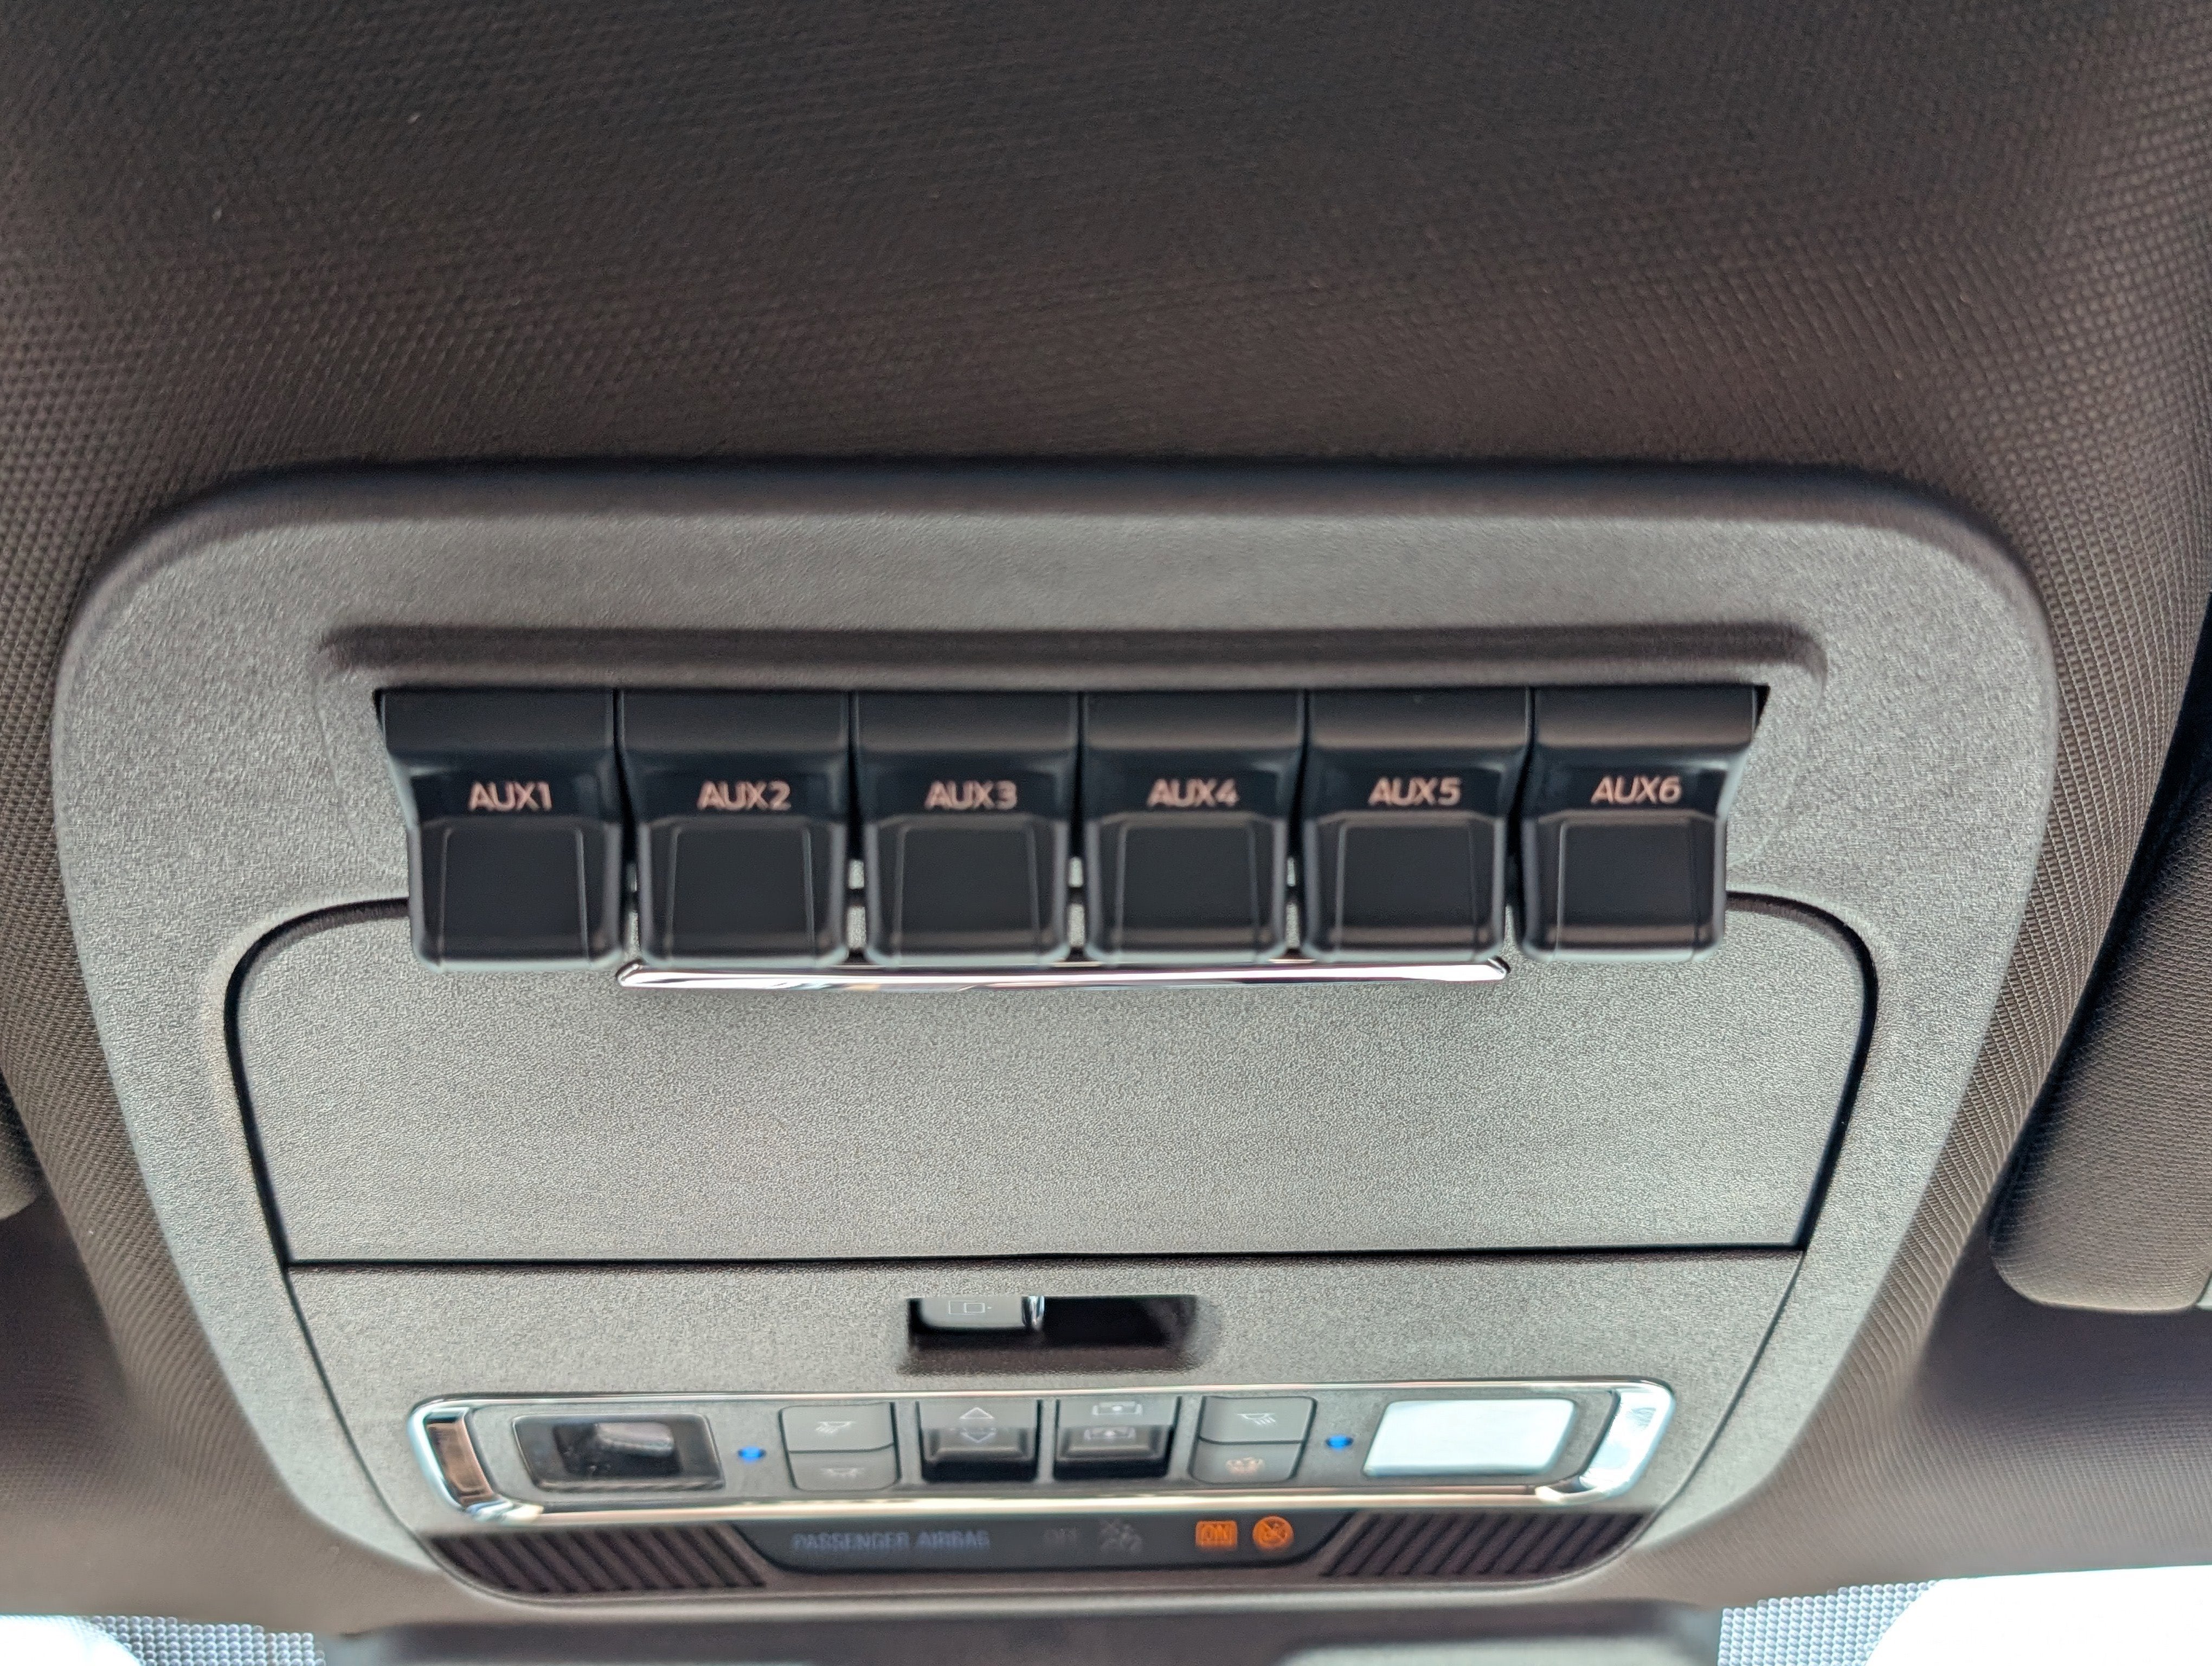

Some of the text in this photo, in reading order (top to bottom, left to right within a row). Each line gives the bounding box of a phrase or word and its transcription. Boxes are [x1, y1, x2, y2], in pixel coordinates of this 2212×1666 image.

[470, 783, 551, 810] AUX1
[698, 781, 790, 810] AUX2
[926, 781, 1017, 809] AUX3
[1148, 779, 1237, 807] AUX4
[1369, 778, 1460, 805] AUX5
[1591, 776, 1681, 804] AUX6
[792, 1532, 910, 1549] PASSENGER
